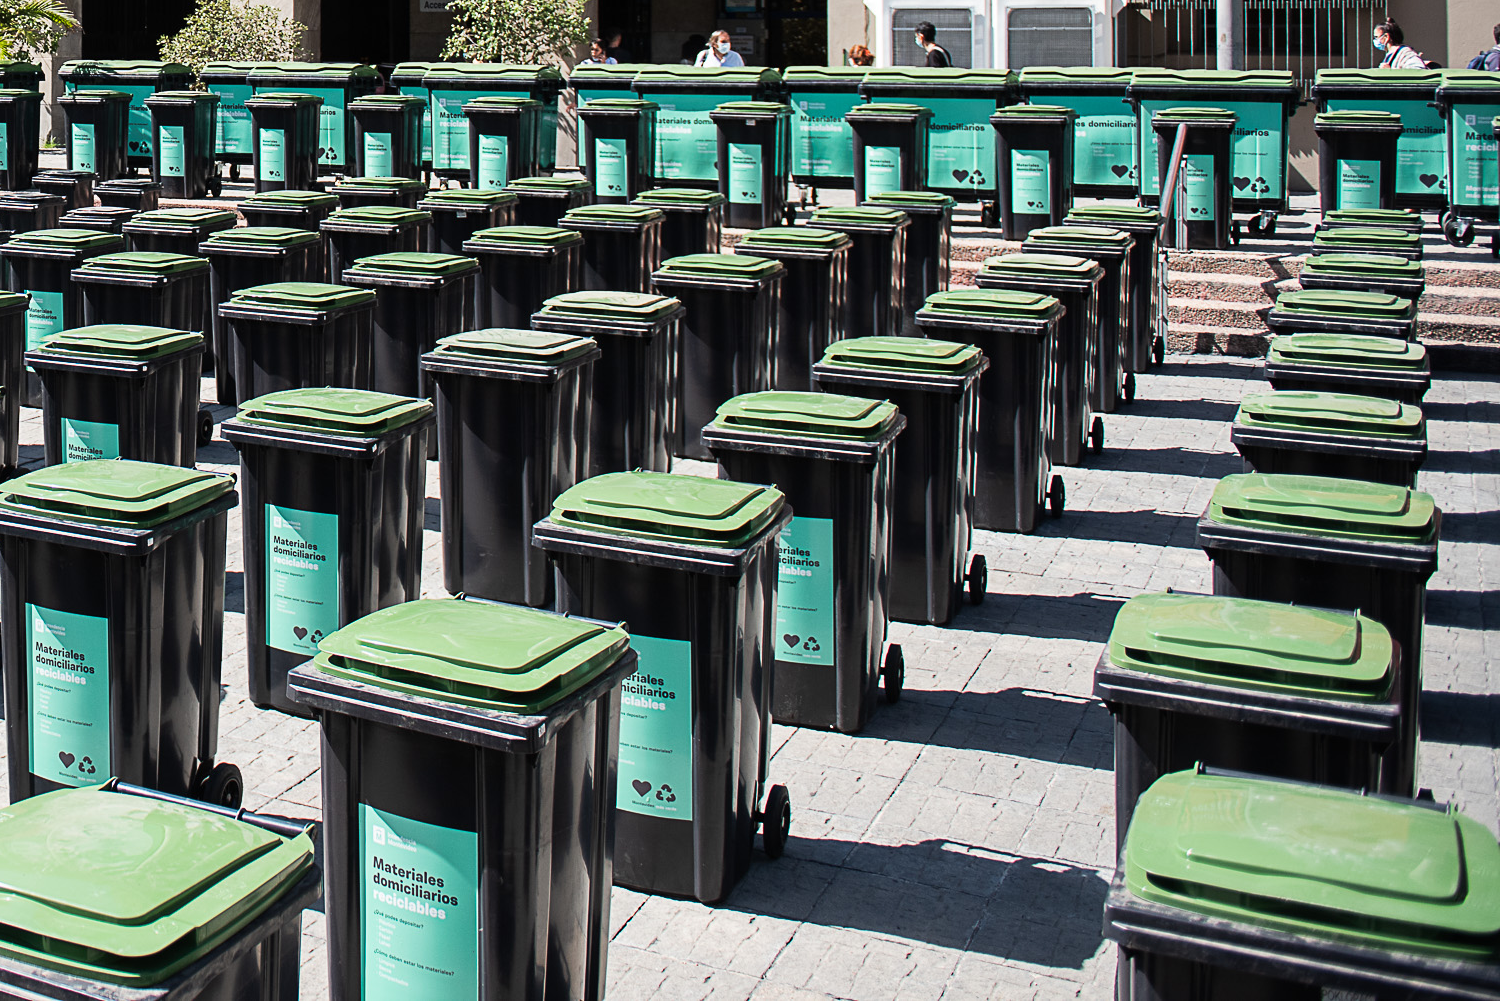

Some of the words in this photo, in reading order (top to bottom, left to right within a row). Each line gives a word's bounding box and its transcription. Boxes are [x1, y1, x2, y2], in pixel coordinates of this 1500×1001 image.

[929, 123, 985, 132] domiciliarios
[69, 444, 103, 455] Materiales
[273, 536, 318, 551] Materiales
[273, 545, 326, 562] domiciliarios
[274, 556, 319, 571] reciclables
[36, 641, 85, 661] Materiales
[36, 653, 95, 674] domiciliarios
[36, 667, 86, 685] reciclables
[623, 673, 664, 686] eriales
[373, 856, 444, 888] Materiales
[373, 873, 458, 906] domiciliarios
[373, 889, 446, 920] reciclables
[425, 966, 454, 976] materiales?
